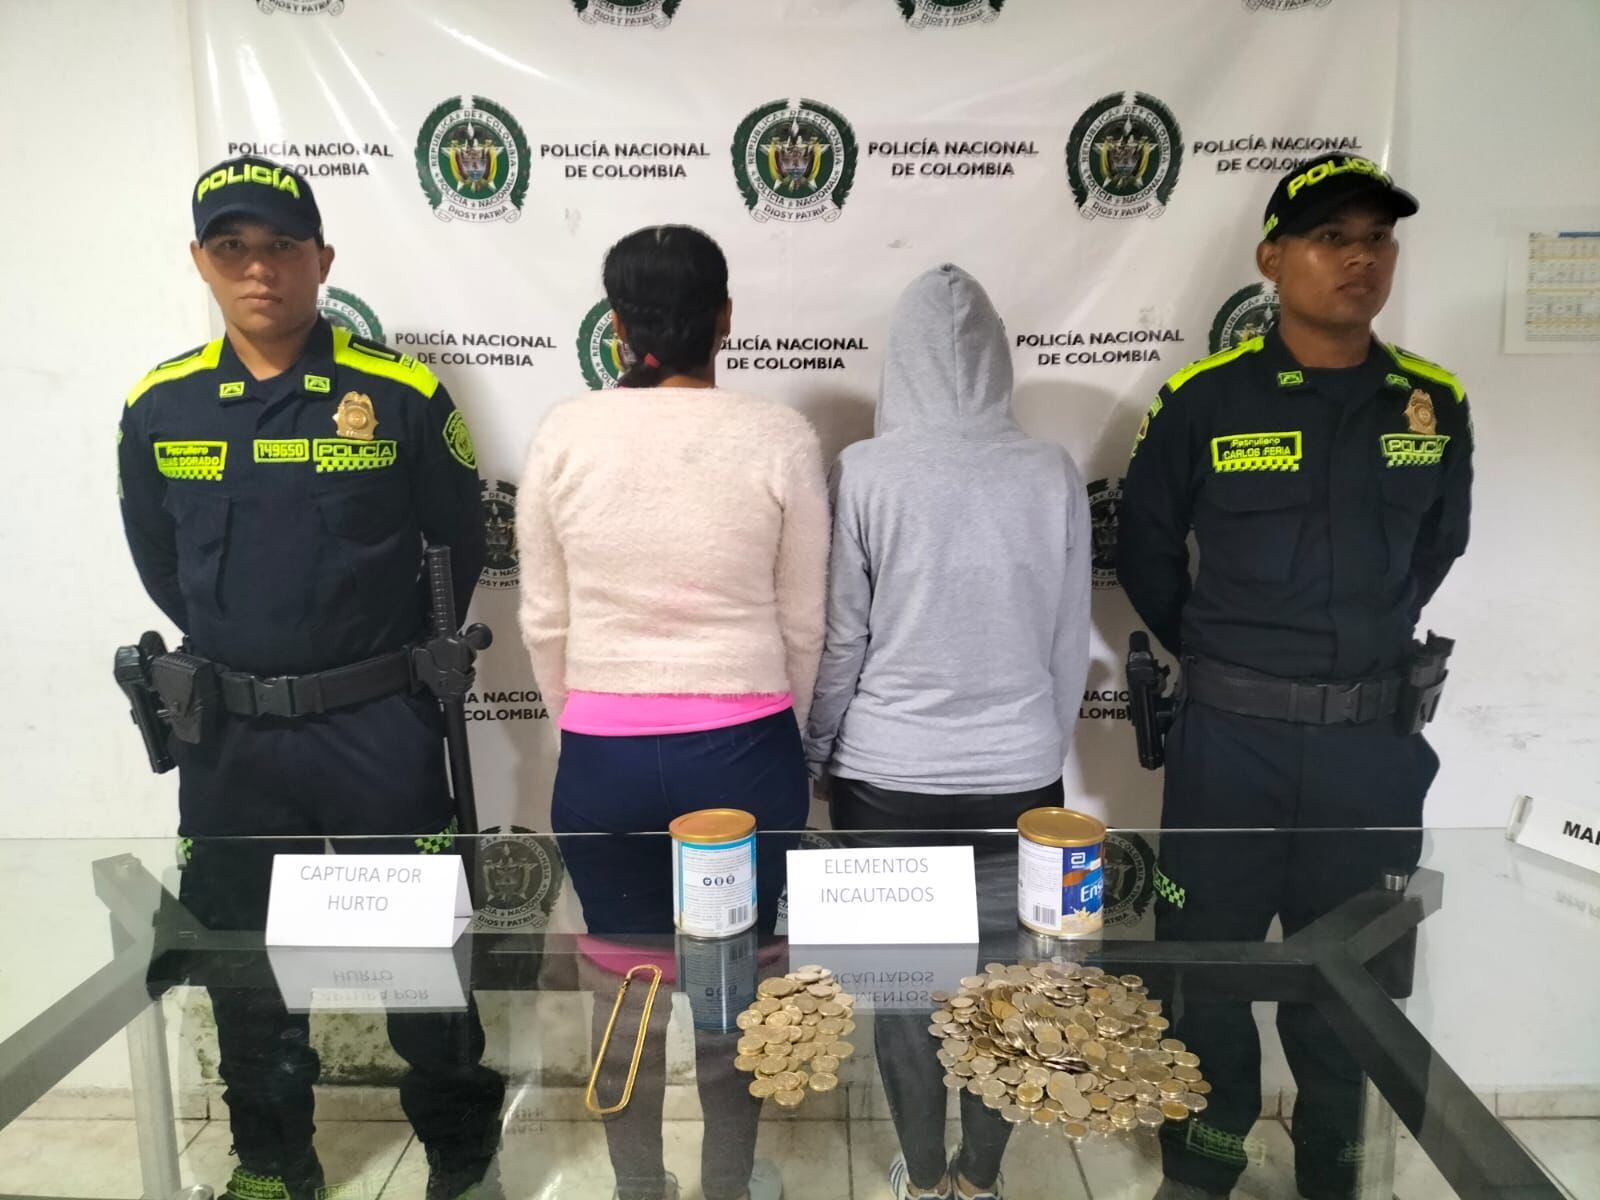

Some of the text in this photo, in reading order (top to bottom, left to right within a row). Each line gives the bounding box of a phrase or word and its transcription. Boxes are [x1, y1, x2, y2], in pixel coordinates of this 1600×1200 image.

[228, 141, 300, 156] POLICÍA
[540, 140, 711, 157] POLICÍA NACIONAL
[868, 138, 1040, 156] POLICÍA NACIONAL
[1193, 135, 1363, 154] POLICÍA NACIONAL
[285, 162, 369, 177] OLOMBIA
[565, 164, 687, 178] DE COLOMBIA
[891, 162, 1016, 176] DE COLOMBIA
[1216, 158, 1242, 172] DE
[341, 305, 369, 336] COLOM
[395, 330, 557, 348] POLICÍA NACIONAL
[592, 312, 613, 357] REPUBLIC
[1016, 329, 1185, 347] POLICÍA NACIONAL
[776, 338, 869, 350] NACIONAL
[417, 352, 534, 367] DE COLOMBIA
[727, 357, 845, 370] DE COLOMBIA
[1038, 349, 1161, 366] DE COLOMBIA
[1223, 446, 1291, 460] CARLOS FERIA
[484, 691, 542, 703] NACIO
[1079, 707, 1127, 720] LOMB
[1562, 820, 1600, 846] MA
[824, 857, 930, 875] ELEMENTOS
[300, 865, 423, 884] CAPTURA POR
[327, 895, 390, 911] HURTO
[820, 886, 935, 904] INCAUTADOS
